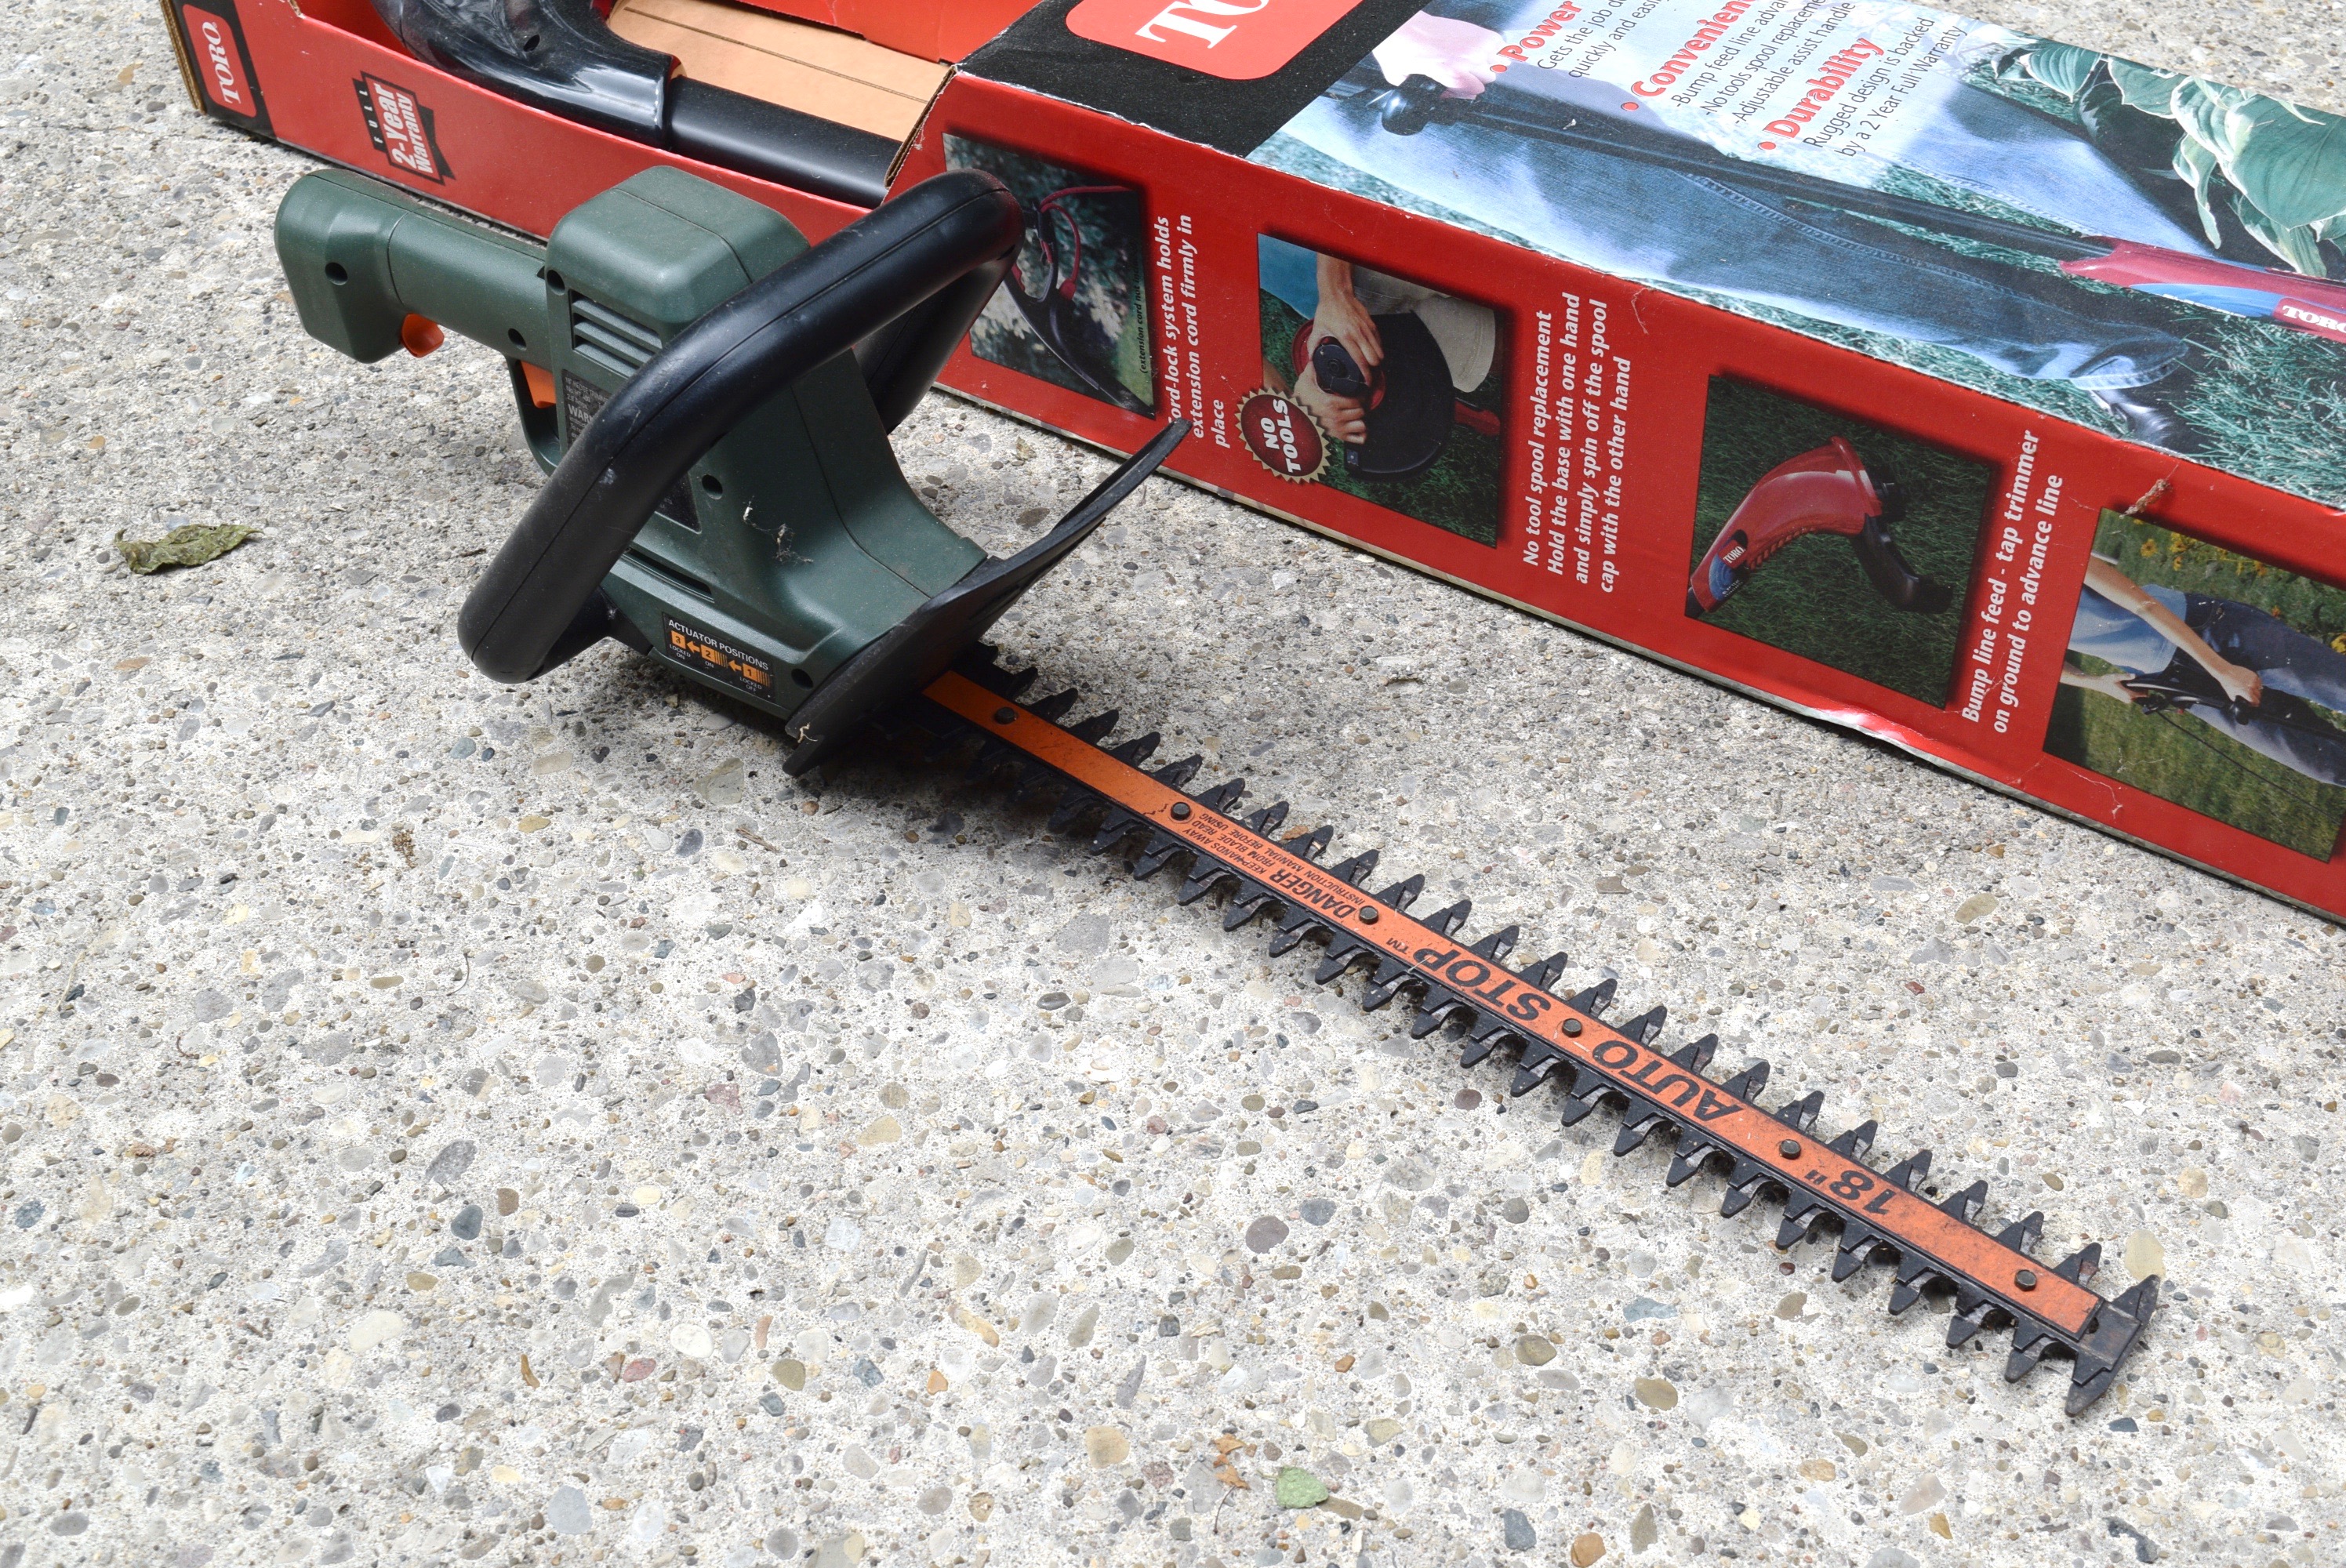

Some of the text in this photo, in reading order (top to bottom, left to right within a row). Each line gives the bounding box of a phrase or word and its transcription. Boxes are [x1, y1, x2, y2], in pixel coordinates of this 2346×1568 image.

[202, 22, 241, 103] TORO
[1497, 0, 1582, 62] Power
[1537, 45, 1573, 69] Gets
[1564, 27, 1593, 45] the
[1582, 9, 1612, 28] job
[1568, 41, 1616, 78] quickly
[1608, 18, 1637, 41] and
[1631, 0, 1756, 96] Convenien
[1671, 0, 1789, 107] -Bump feed line adva
[1732, 2, 1856, 124] -Adjustable assist handle
[1699, 96, 1727, 115] -No
[1717, 71, 1752, 96] tools
[1745, 44, 1778, 72] spool
[1763, 38, 1884, 138] Durability
[1803, 16, 1935, 148] Rugged design is backed
[1834, 25, 1967, 157] by a 2 Year Full Warranty
[358, 89, 383, 143] FULL
[373, 82, 417, 169] 2-Year
[395, 92, 434, 174] Warranty
[1134, 303, 1143, 324] cord
[1153, 216, 1182, 423] ord-lock system holds
[1176, 215, 1204, 438] extension cord firmly in
[1137, 327, 1148, 373] (extension
[1211, 399, 1230, 448] place
[1260, 417, 1280, 450] NO
[1273, 398, 1302, 473] TOOLS
[1523, 310, 1552, 566] No tool spool replacement
[1547, 292, 1580, 575] Hold the base with one hand
[1573, 299, 1610, 584] and simply spin off the spool
[1600, 356, 1631, 593] cap with the other hand
[2004, 430, 2039, 521] trimmer
[1723, 546, 1746, 563] TORO
[1996, 526, 2023, 562] tap
[1981, 578, 2007, 624] feed
[1993, 475, 2063, 733] on ground to advance line
[669, 619, 768, 670] ACTUATOR POSITIONS
[669, 644, 691, 658] LOCKED
[677, 652, 685, 660] ON
[705, 660, 714, 669] ON
[1972, 628, 1997, 665] line
[739, 676, 762, 690] LOCKED
[1961, 668, 1993, 723] Bump
[1182, 828, 1268, 875] KEEP HANDS AWAY
[1192, 820, 1273, 868] FROM BLADE READ
[1199, 813, 1364, 906] INSTRUCTION MANUAL BEFORE USING
[1269, 868, 1358, 918] DANGER
[1385, 938, 1898, 1215] 18" AUTO STOP TM
